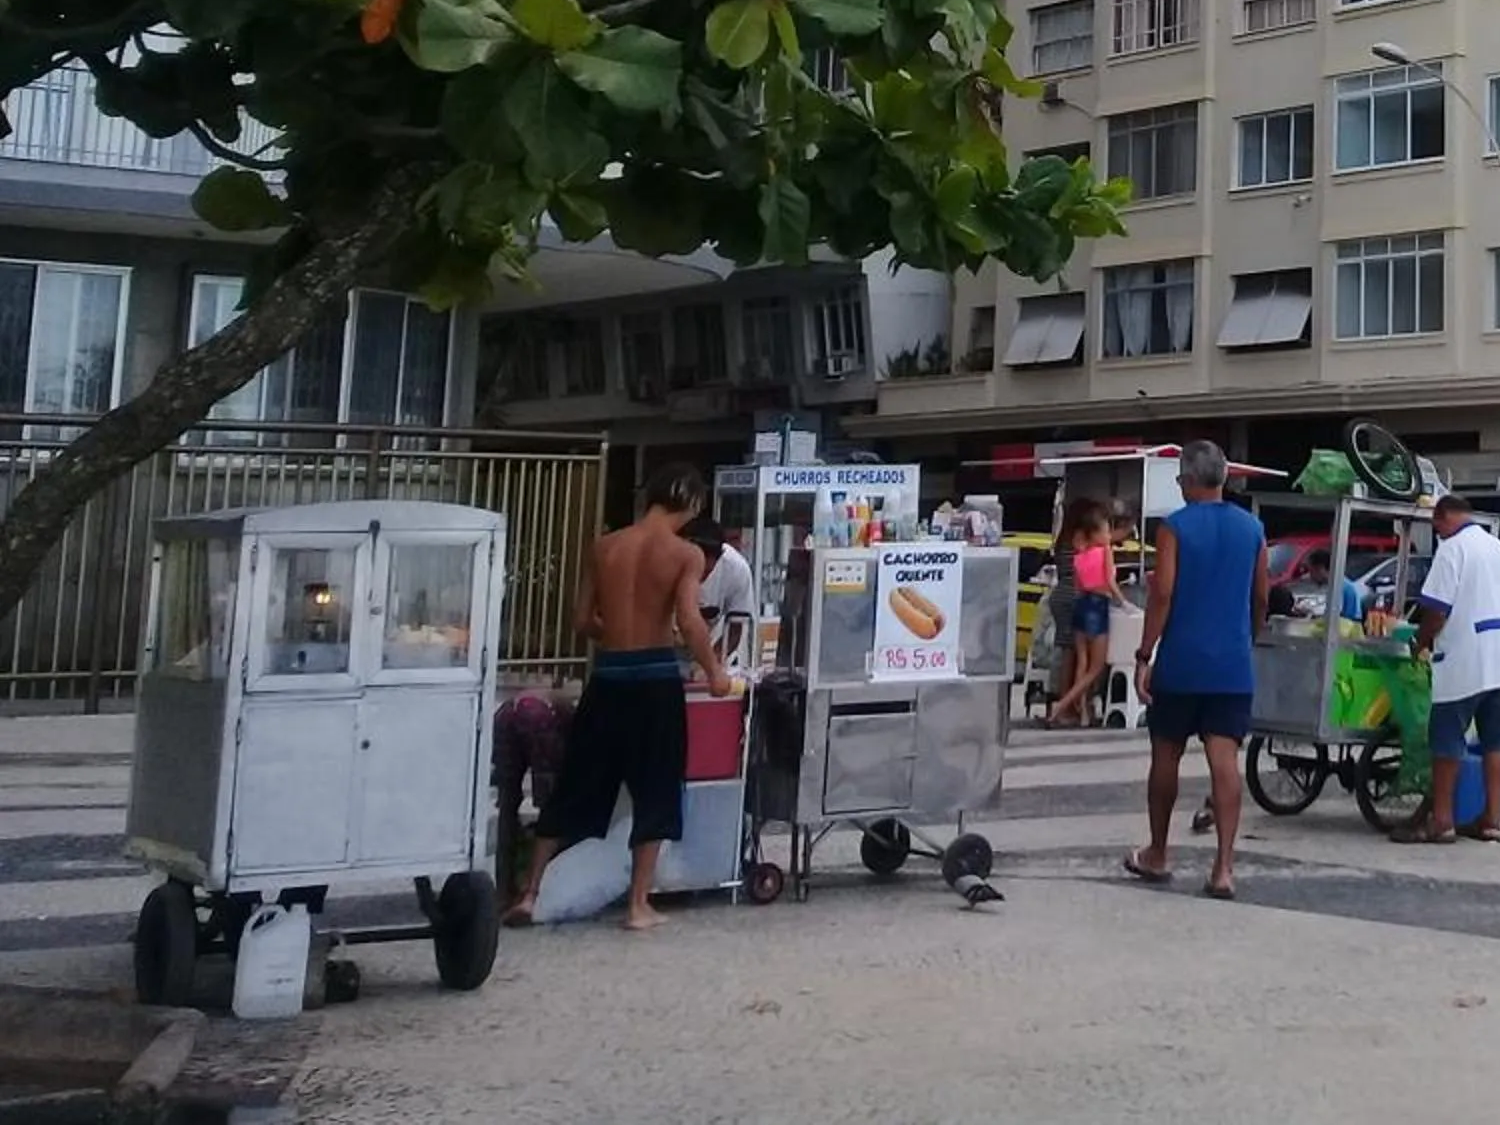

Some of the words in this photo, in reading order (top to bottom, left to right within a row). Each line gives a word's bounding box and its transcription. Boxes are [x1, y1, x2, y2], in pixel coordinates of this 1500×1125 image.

[775, 471, 831, 485] CHURROS
[837, 470, 905, 484] RECHEADOS
[883, 552, 959, 565] CACHORRO
[895, 569, 946, 582] QUENTE
